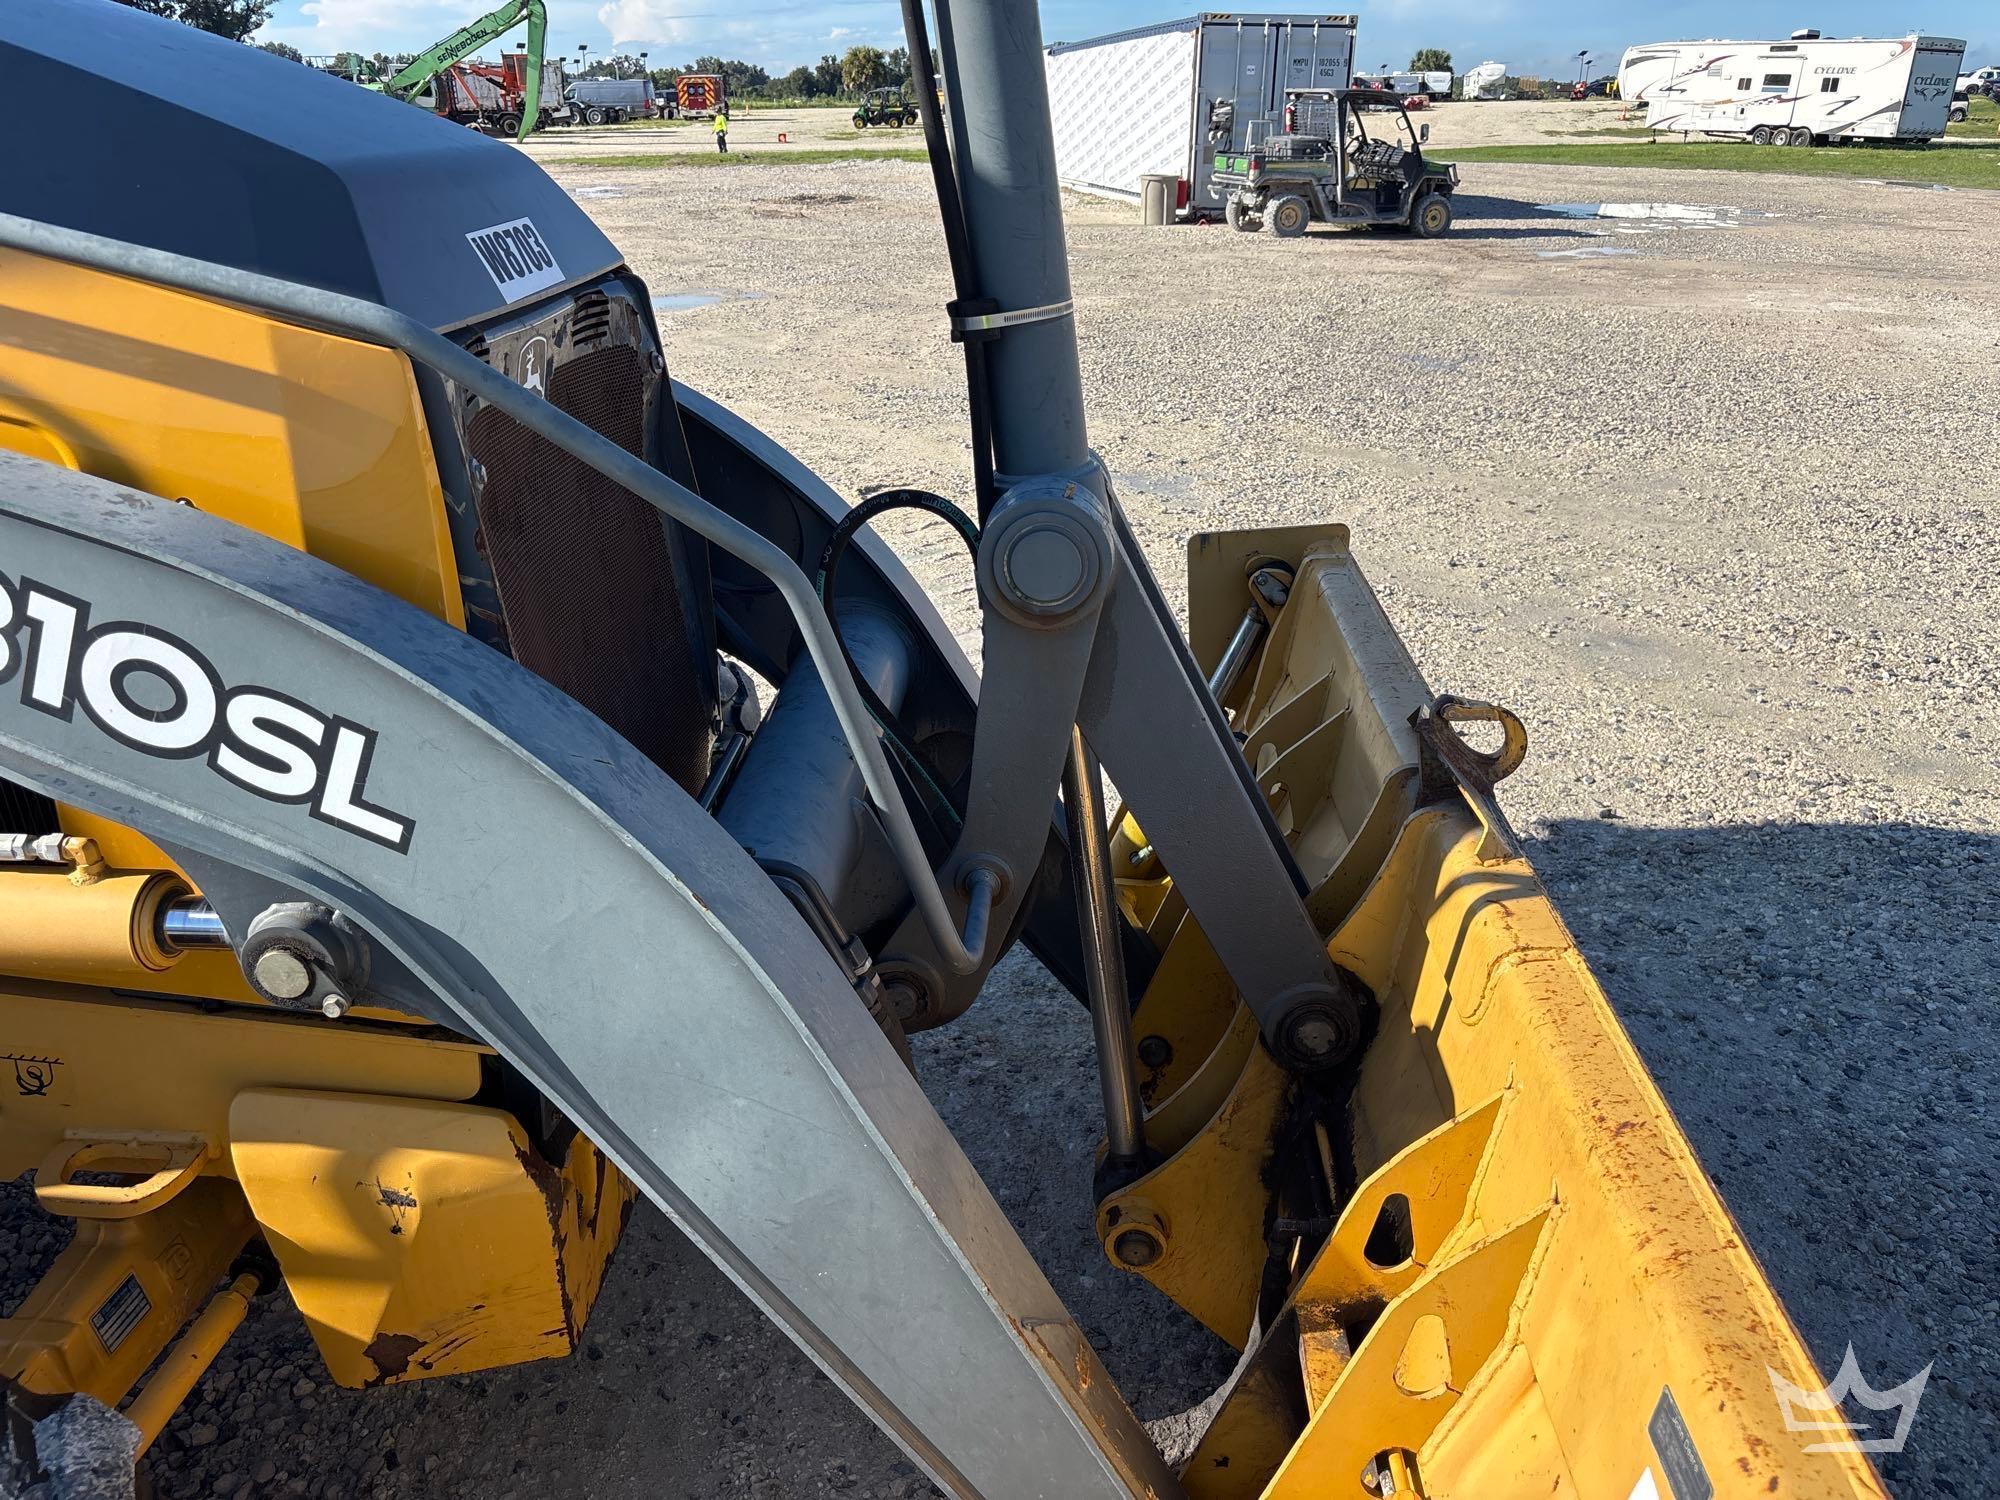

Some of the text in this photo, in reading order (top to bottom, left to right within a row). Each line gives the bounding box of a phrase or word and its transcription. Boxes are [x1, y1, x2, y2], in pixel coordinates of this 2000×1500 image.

[437, 28, 489, 64] SENNEBOGEN
[1293, 58, 1308, 67] MMPU
[1319, 58, 1340, 67] 102055
[1320, 69, 1334, 77] 45G3
[1814, 65, 1857, 75] CYCLONE
[1914, 73, 1952, 87] CYCLONE
[472, 223, 553, 284] W8703
